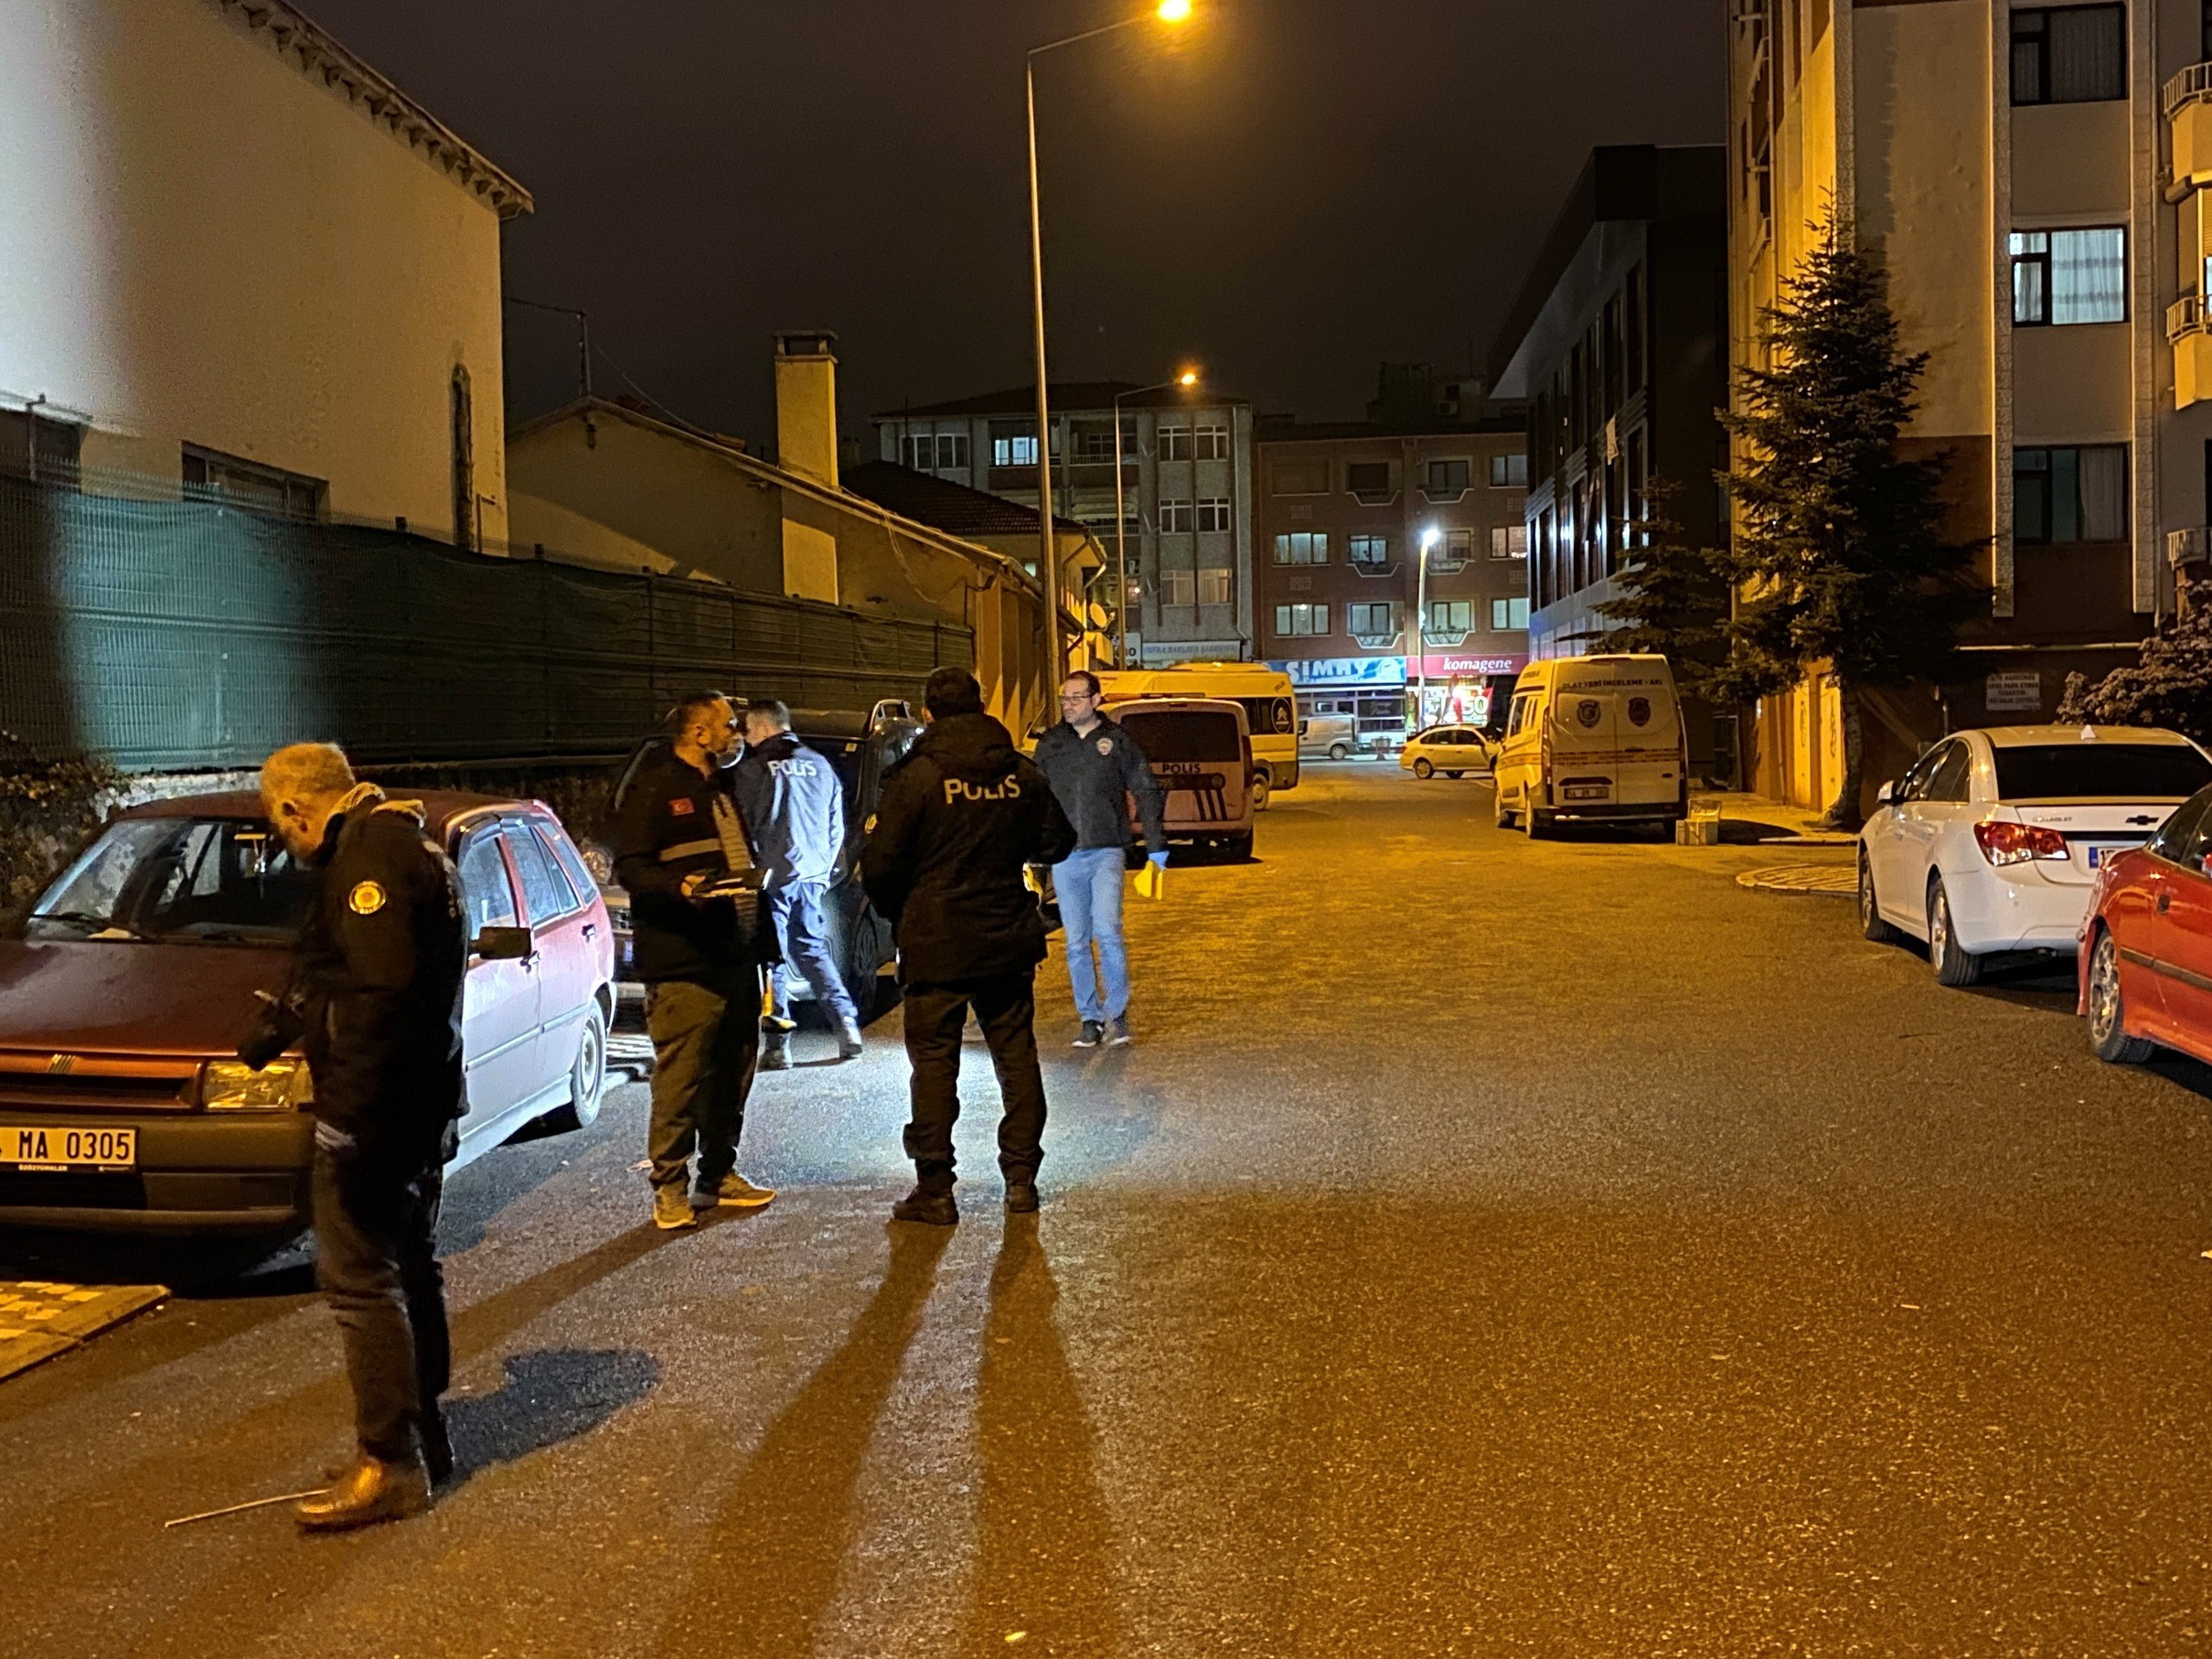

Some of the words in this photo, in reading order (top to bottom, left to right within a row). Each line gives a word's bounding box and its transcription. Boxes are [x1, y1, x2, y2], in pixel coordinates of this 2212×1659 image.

[1442, 657, 1512, 673] komagene
[18, 1129, 49, 1160] MA
[66, 1131, 130, 1161] 0305
